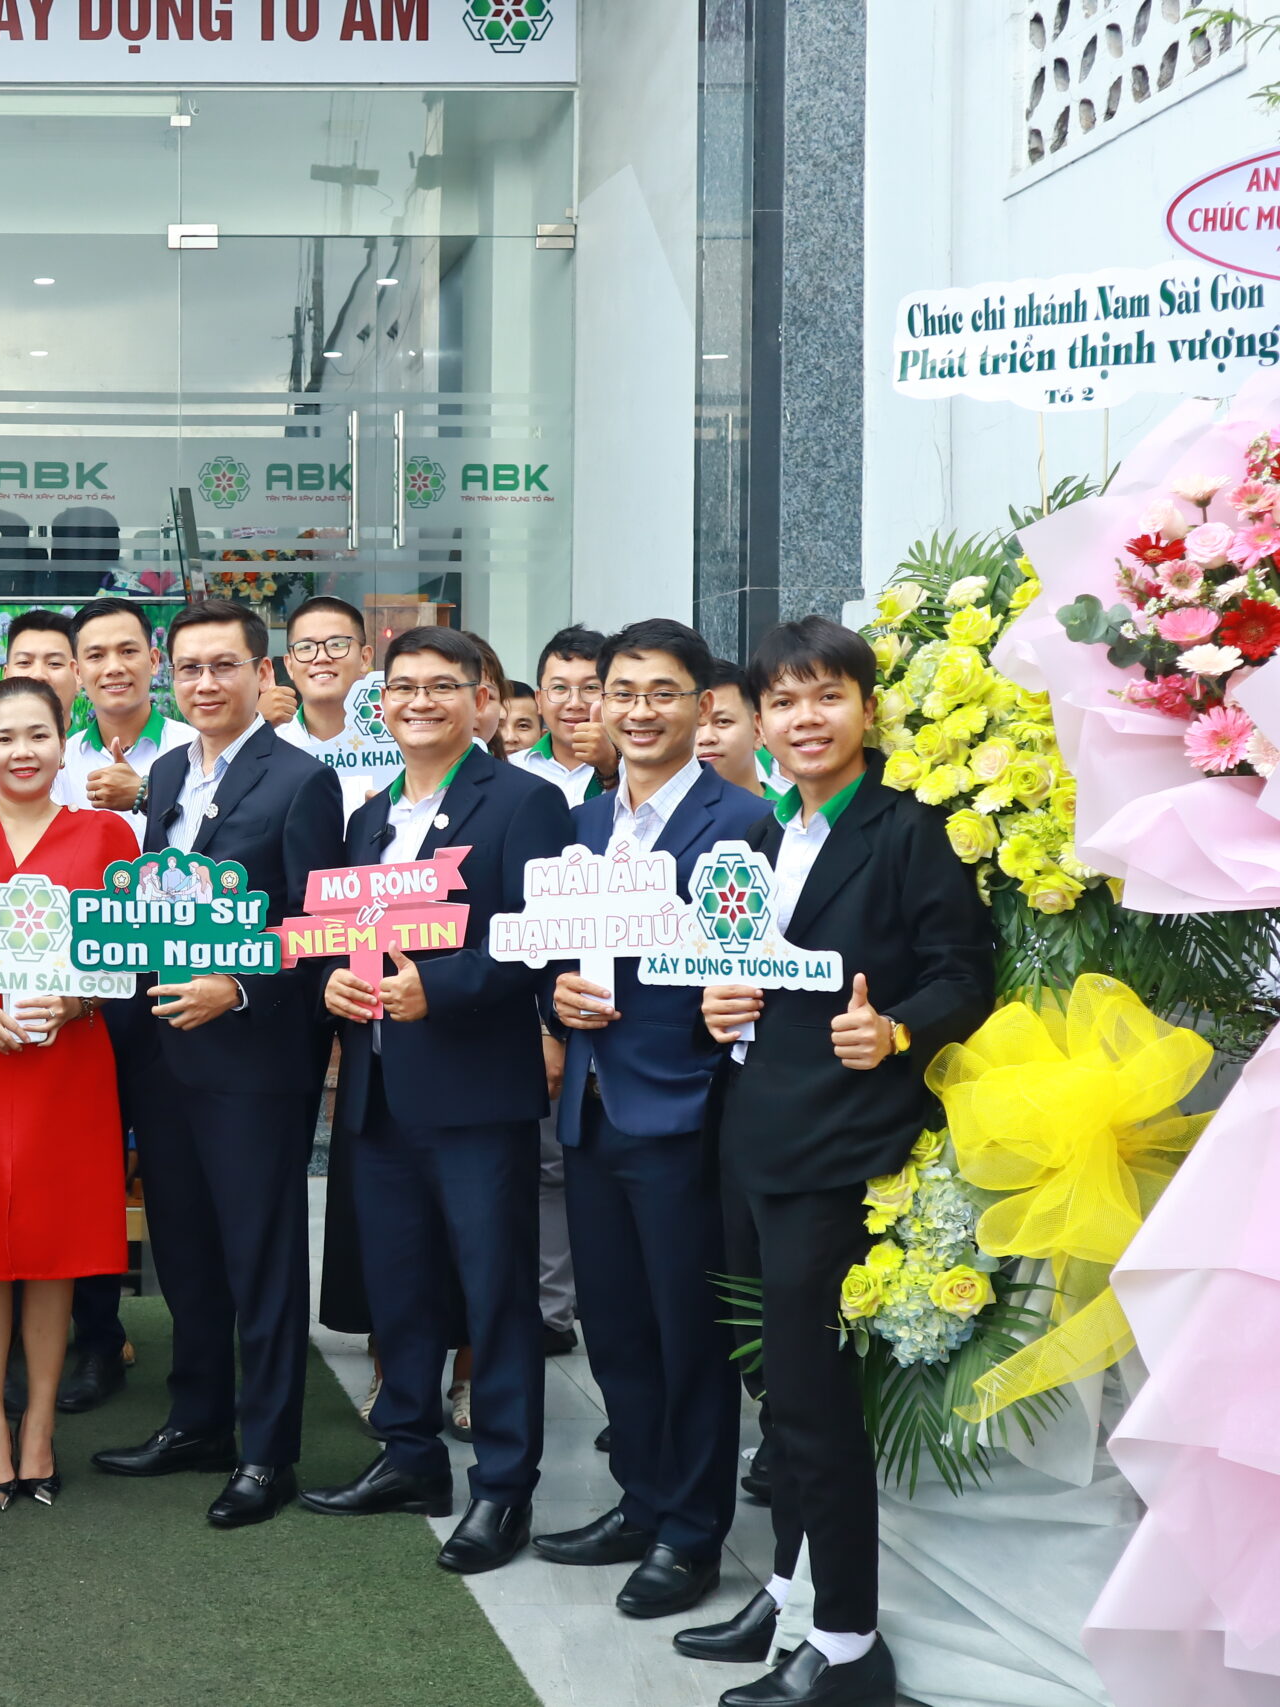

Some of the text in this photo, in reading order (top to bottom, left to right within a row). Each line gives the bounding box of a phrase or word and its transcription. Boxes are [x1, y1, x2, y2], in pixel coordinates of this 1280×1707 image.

[1188, 201, 1250, 232] CHÚC
[907, 272, 1264, 338] Chúc chi nhánh Nam Sài Gòn
[897, 324, 1280, 382] Phát triển thịnh vượng
[1081, 387, 1095, 402] 2
[265, 463, 352, 491] ABK
[461, 463, 550, 491] ABK
[323, 748, 357, 768] BẢO
[320, 866, 438, 901] MỞ RỘNG
[531, 841, 666, 896] MÁI ẤM
[77, 898, 261, 929] Phụng Sự
[287, 918, 457, 955] NIỀM TIN
[496, 917, 597, 959] HẠNH
[77, 938, 274, 968] Con Người
[647, 953, 832, 980] XÂY DỰNG TƯƠNG LAI
[35, 968, 71, 992] SÀI
